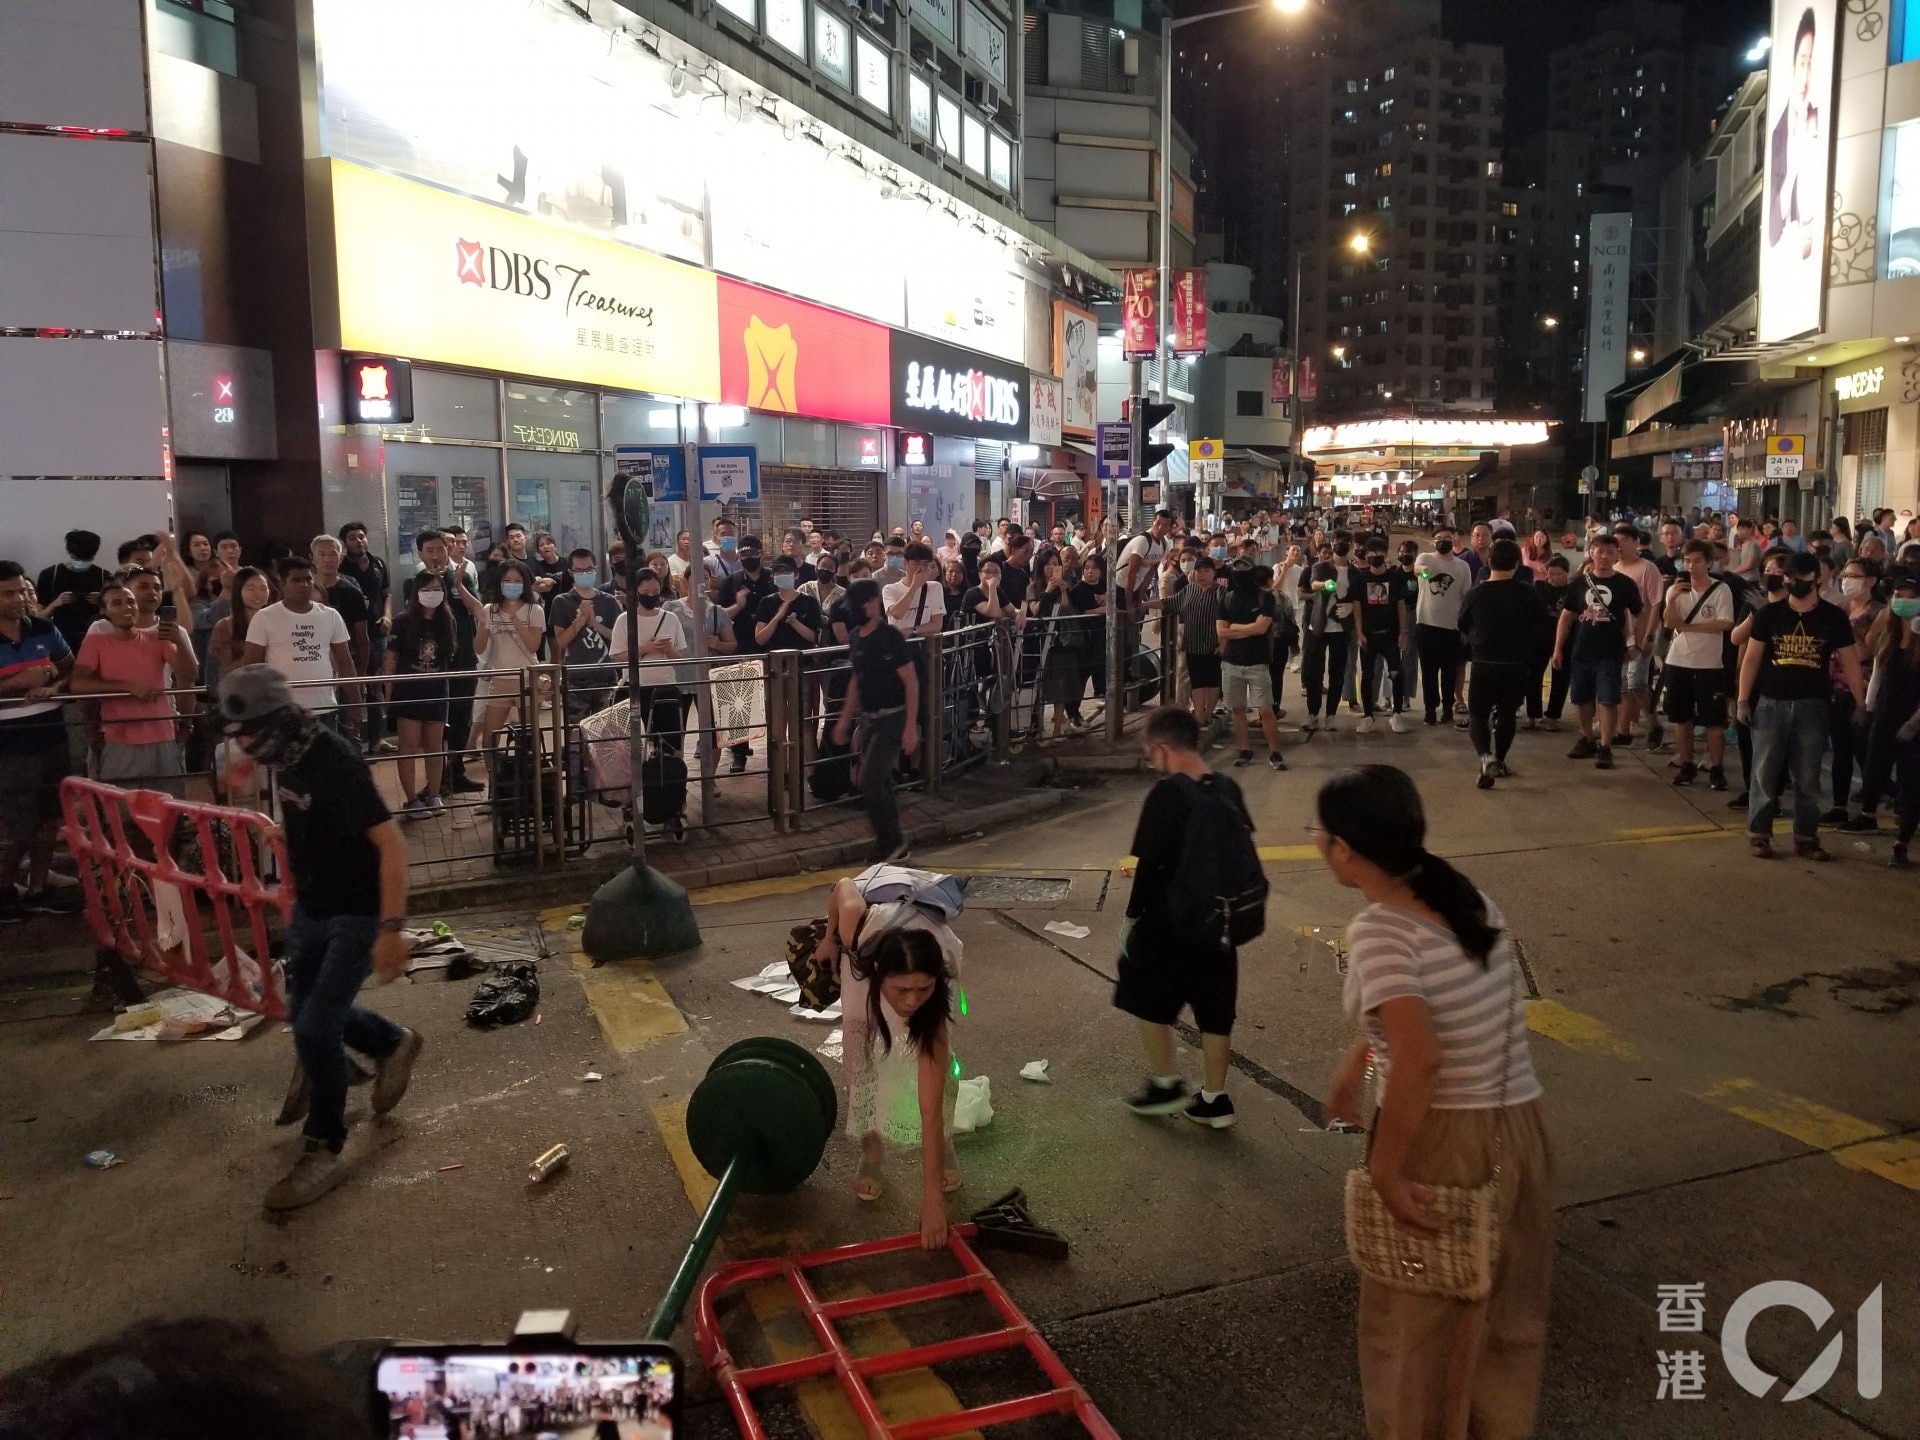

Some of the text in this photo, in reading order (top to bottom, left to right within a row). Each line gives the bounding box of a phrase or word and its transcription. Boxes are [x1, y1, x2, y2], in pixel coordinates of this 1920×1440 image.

[825, 21, 839, 57] 教
[822, 56, 843, 77] Education
[1594, 245, 1626, 256] NCB
[489, 246, 653, 327] DBS Treasures
[1126, 295, 1153, 319] 70
[1601, 262, 1614, 350] 南洋商業銀行
[984, 375, 1019, 426] DBS
[1206, 461, 1219, 469] hrs
[1773, 466, 1795, 475] 全日
[292, 638, 307, 647] not
[299, 643, 321, 652] good
